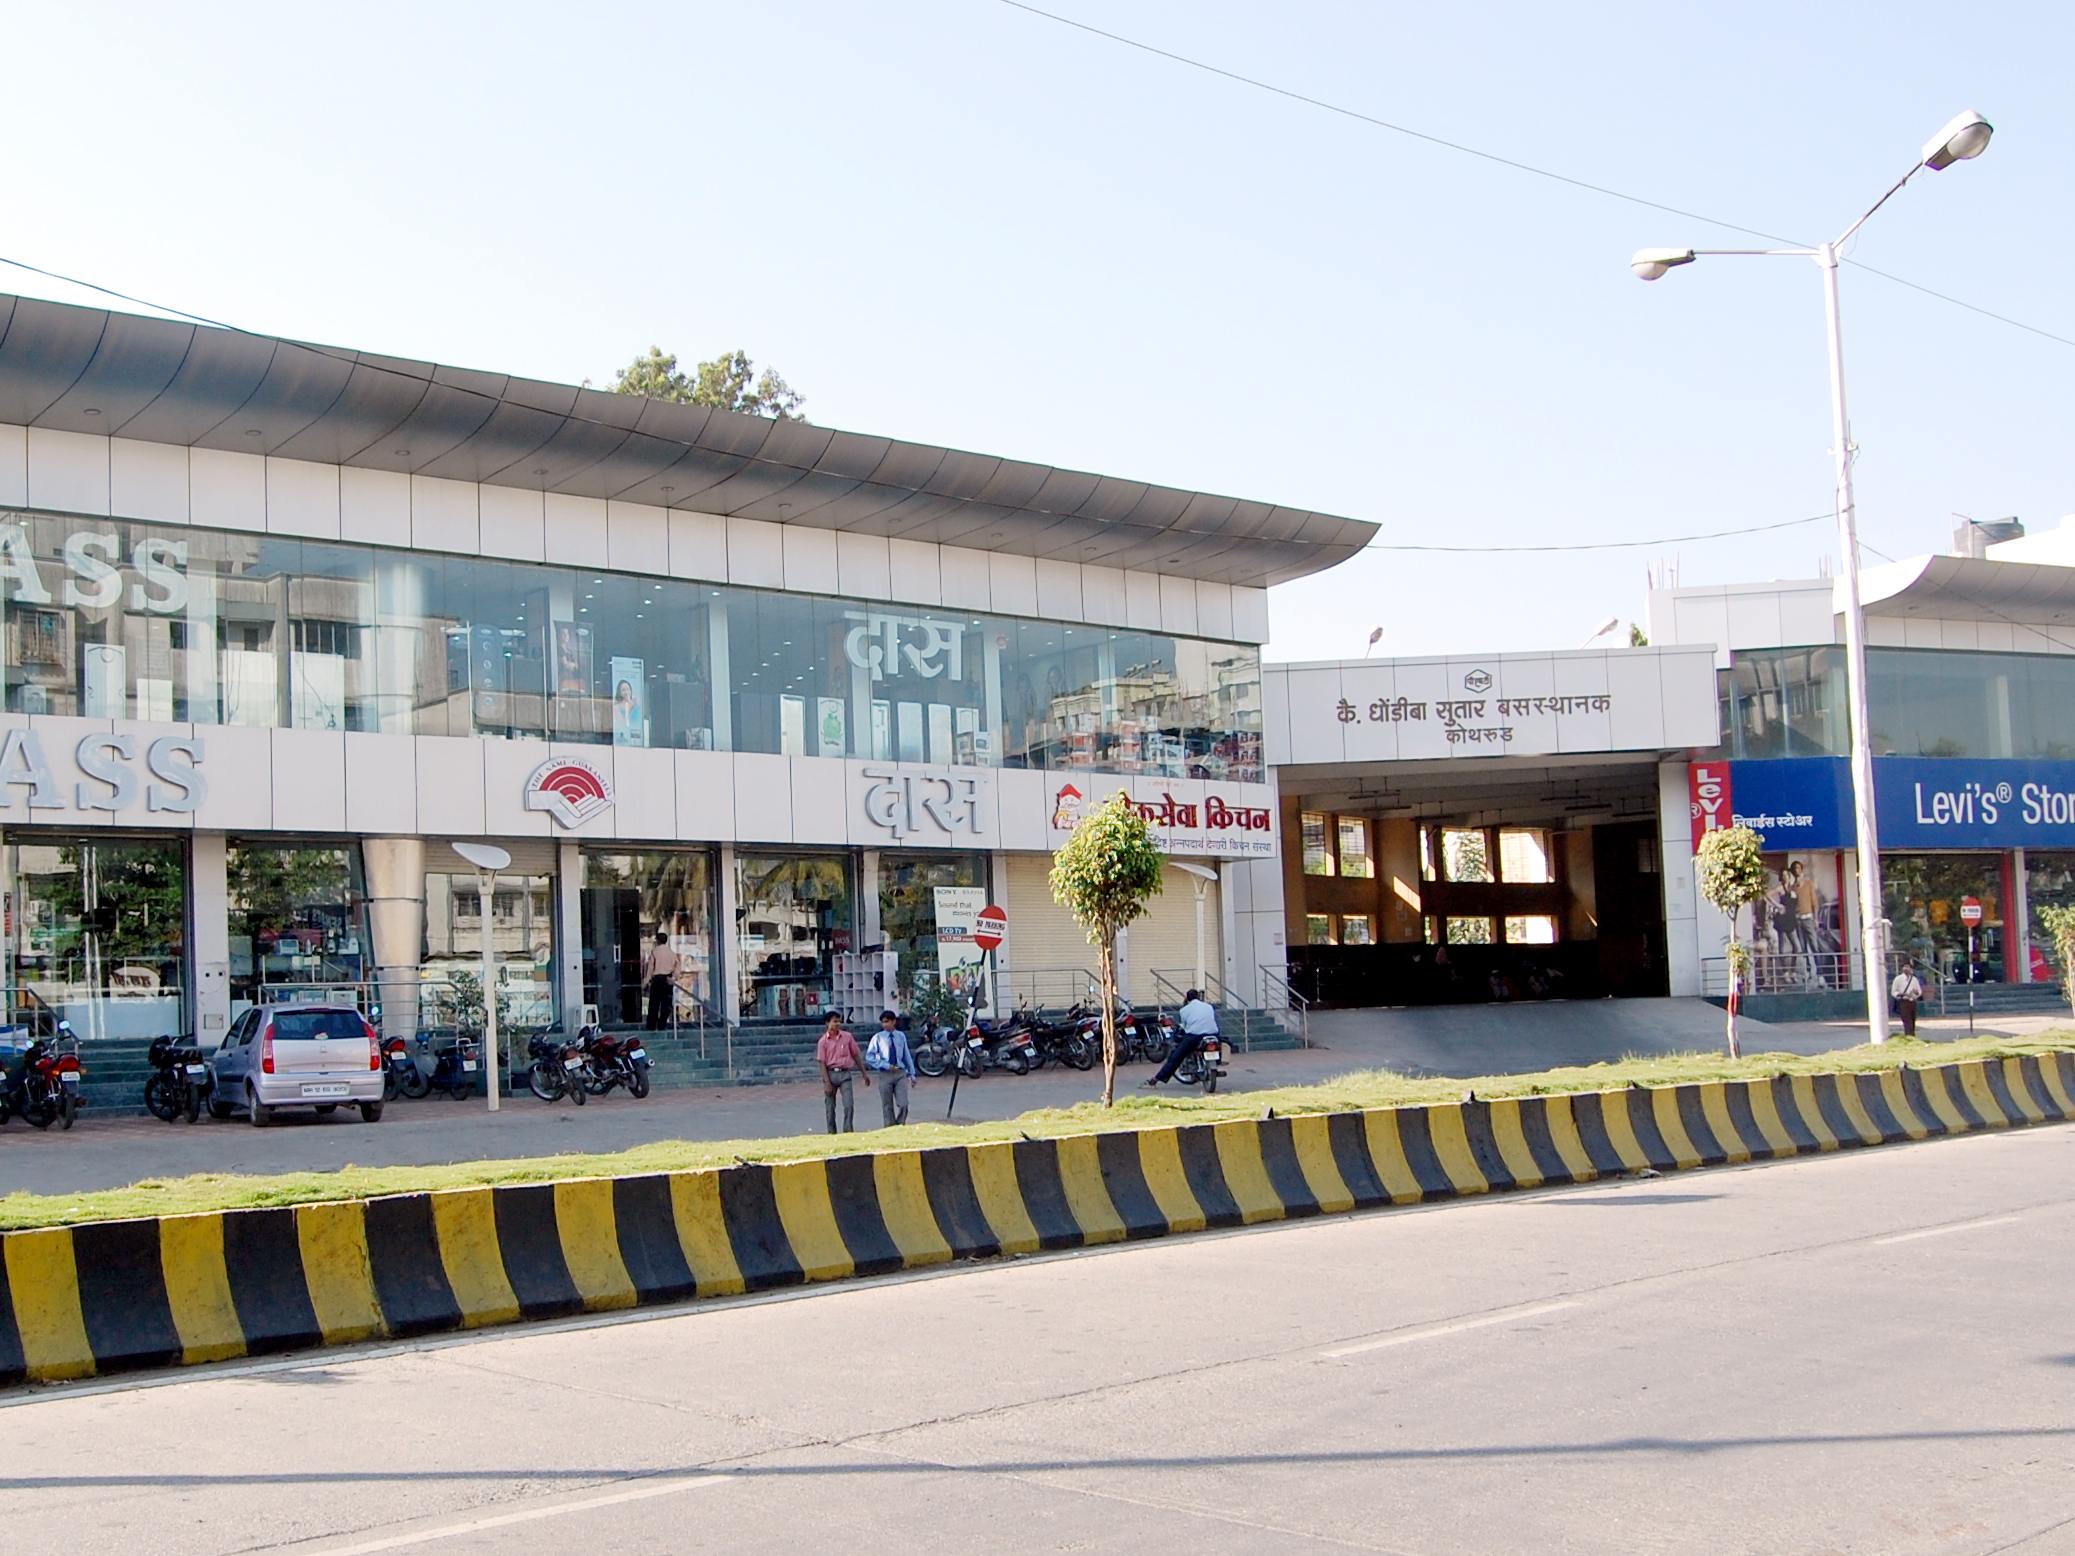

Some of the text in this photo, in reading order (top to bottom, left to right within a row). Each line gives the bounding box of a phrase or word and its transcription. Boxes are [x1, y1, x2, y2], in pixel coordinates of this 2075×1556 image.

[844, 610, 966, 681] दास
[1337, 694, 1611, 726] कै. धोंडीबा सुतार बसस्थानक
[1446, 724, 1513, 744] कोथरुड
[862, 767, 986, 839] दास
[1204, 795, 1271, 832] किचन
